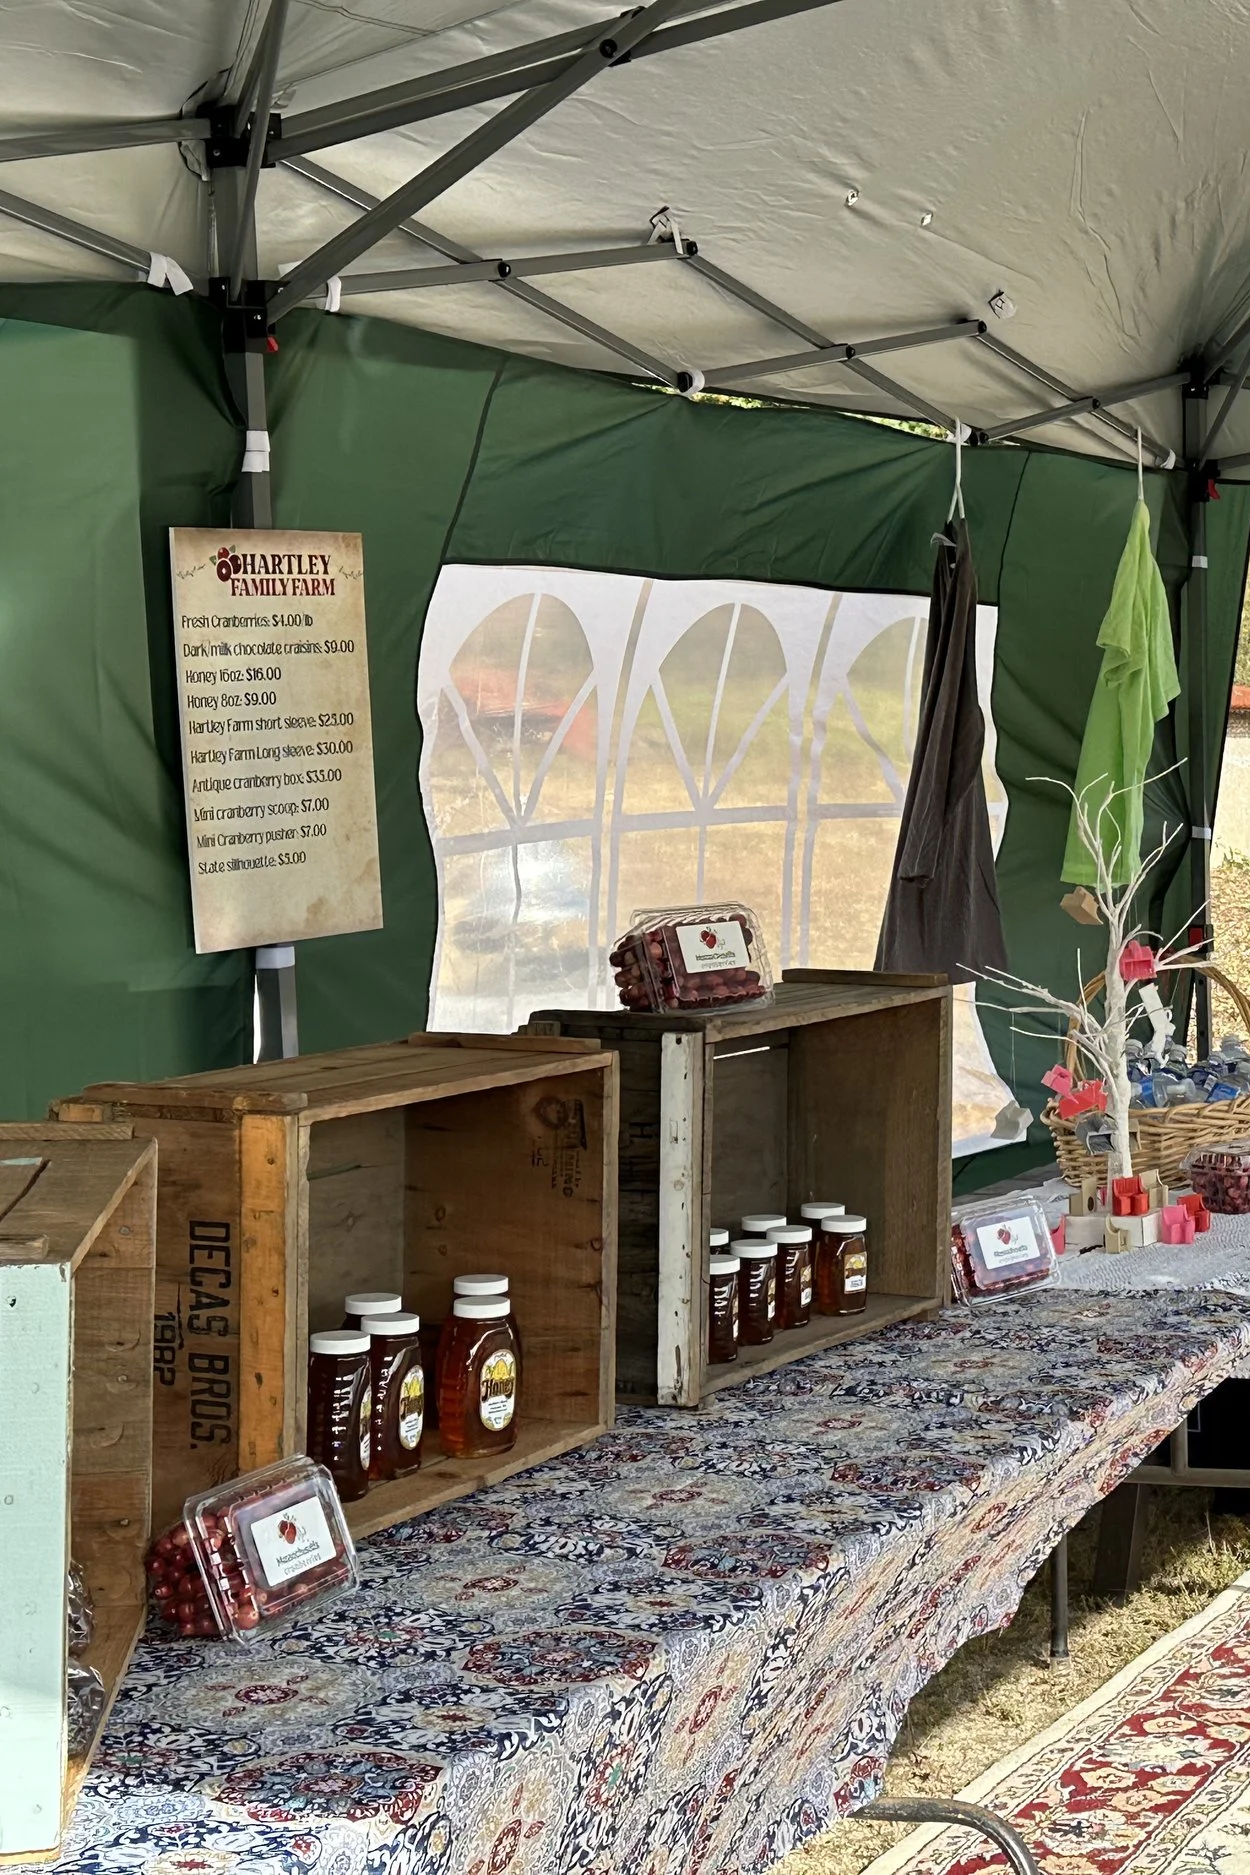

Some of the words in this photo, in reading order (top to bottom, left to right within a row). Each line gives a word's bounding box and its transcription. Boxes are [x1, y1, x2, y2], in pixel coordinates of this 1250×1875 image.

[241, 553, 331, 575] HARTLEY
[230, 578, 290, 597] FAMILY
[292, 578, 336, 597] FARM
[181, 614, 210, 628] Fresh
[233, 642, 282, 656] chocolate
[324, 639, 355, 654] $9.00
[185, 669, 217, 685] Honey
[245, 666, 282, 681] $16.00
[187, 694, 218, 710] Honey
[220, 693, 243, 707] 8oz:
[244, 691, 276, 706] $9.00
[188, 719, 226, 735] Hartley
[227, 717, 253, 732] Farm
[255, 716, 283, 731] short
[190, 749, 227, 765] Hartley
[228, 747, 256, 761] Farm
[256, 746, 281, 762] Long
[316, 740, 353, 755] $30.00
[192, 777, 232, 794] Antique
[233, 773, 282, 789] cranberry
[306, 768, 342, 783] $35.00
[193, 806, 215, 822] Mini
[216, 805, 266, 820] cranberry
[267, 802, 299, 816] scoop:
[300, 797, 330, 812] $7.00
[196, 833, 216, 848] Mini
[217, 831, 264, 846] Cranberry
[300, 823, 327, 838] $7.00
[198, 861, 226, 875] State
[277, 850, 307, 866] $5.00
[187, 1219, 232, 1337] DECAS
[187, 1352, 232, 1450] BROS.
